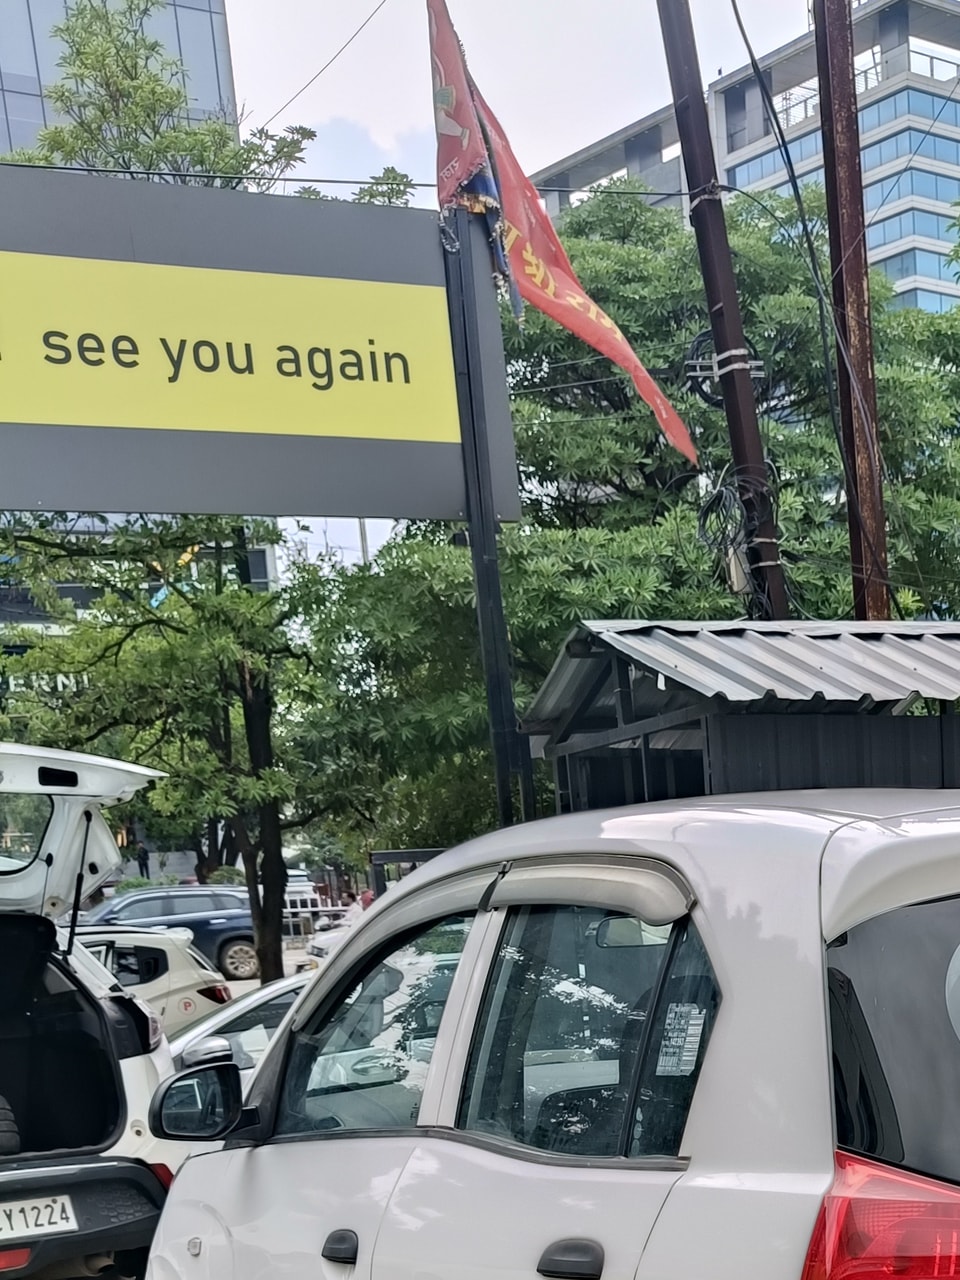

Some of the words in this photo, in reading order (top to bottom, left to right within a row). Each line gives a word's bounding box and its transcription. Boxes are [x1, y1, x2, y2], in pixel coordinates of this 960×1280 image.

[42, 330, 140, 368] see
[159, 337, 255, 383] you
[276, 338, 411, 391] again
[0, 1202, 70, 1232] Y1224
